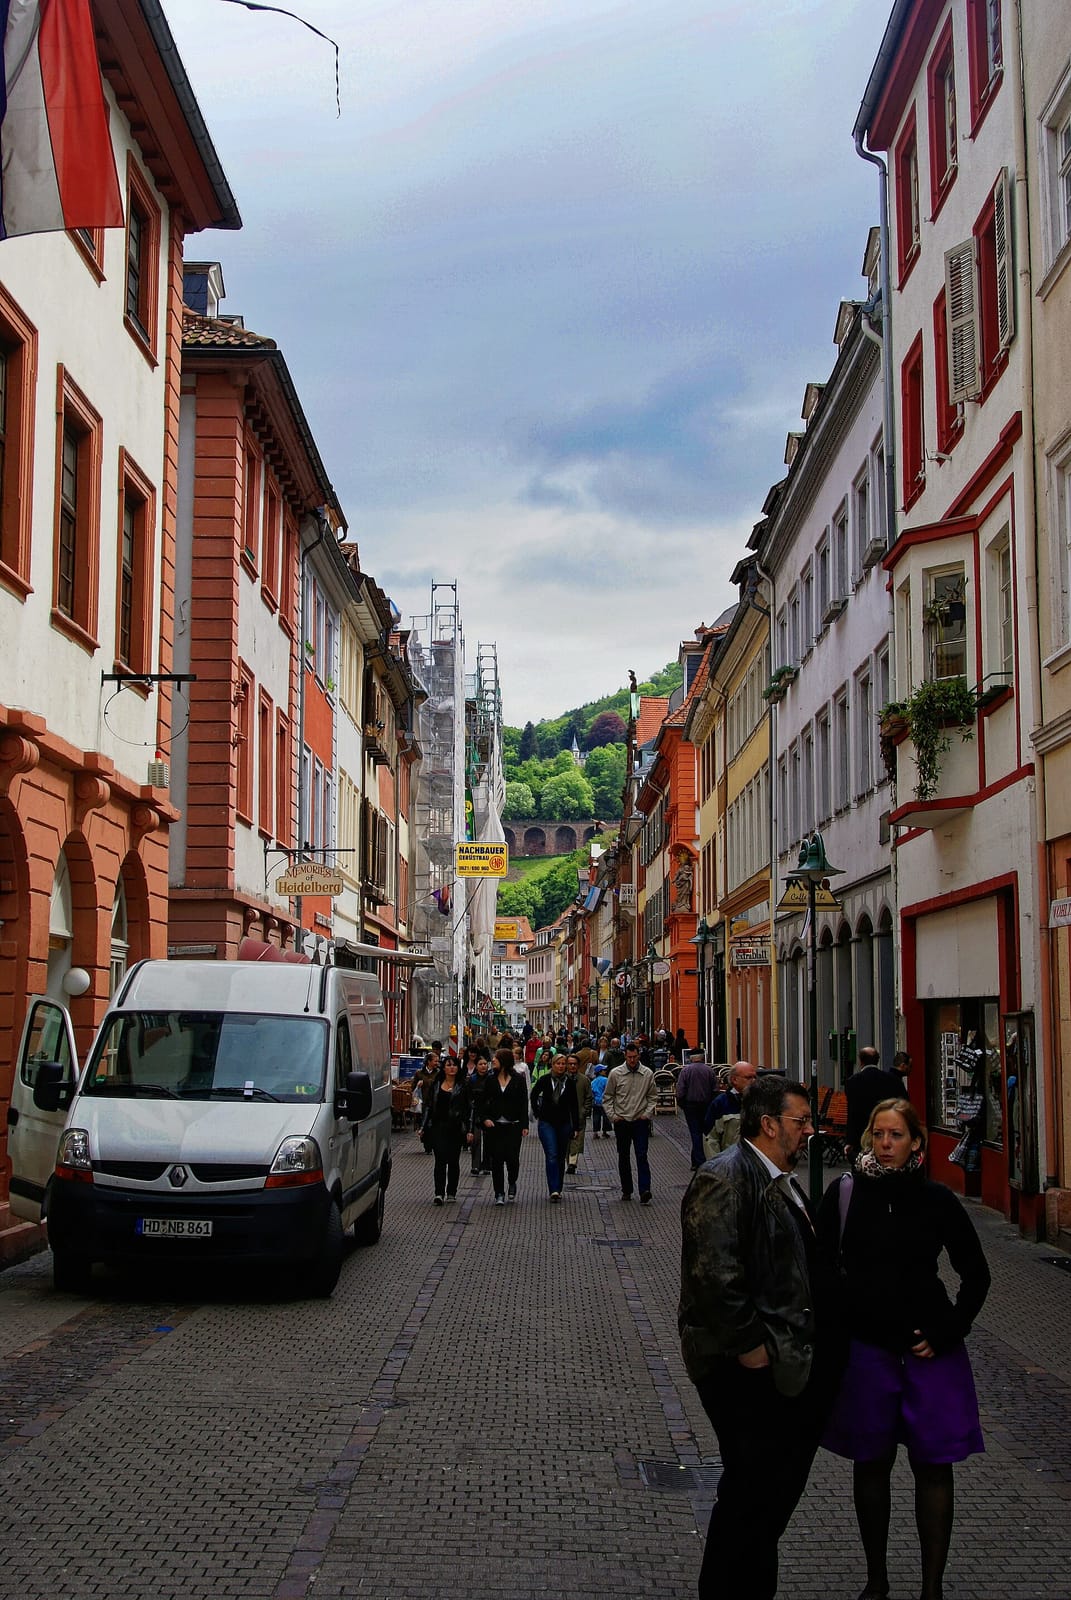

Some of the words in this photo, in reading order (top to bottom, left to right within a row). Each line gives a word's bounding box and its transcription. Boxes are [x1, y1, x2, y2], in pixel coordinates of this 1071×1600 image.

[287, 865, 332, 879] MEMORIES
[278, 881, 341, 894] Heidelberg
[144, 1220, 160, 1233] HD
[168, 1221, 185, 1234] NB
[188, 1222, 211, 1235] 861
